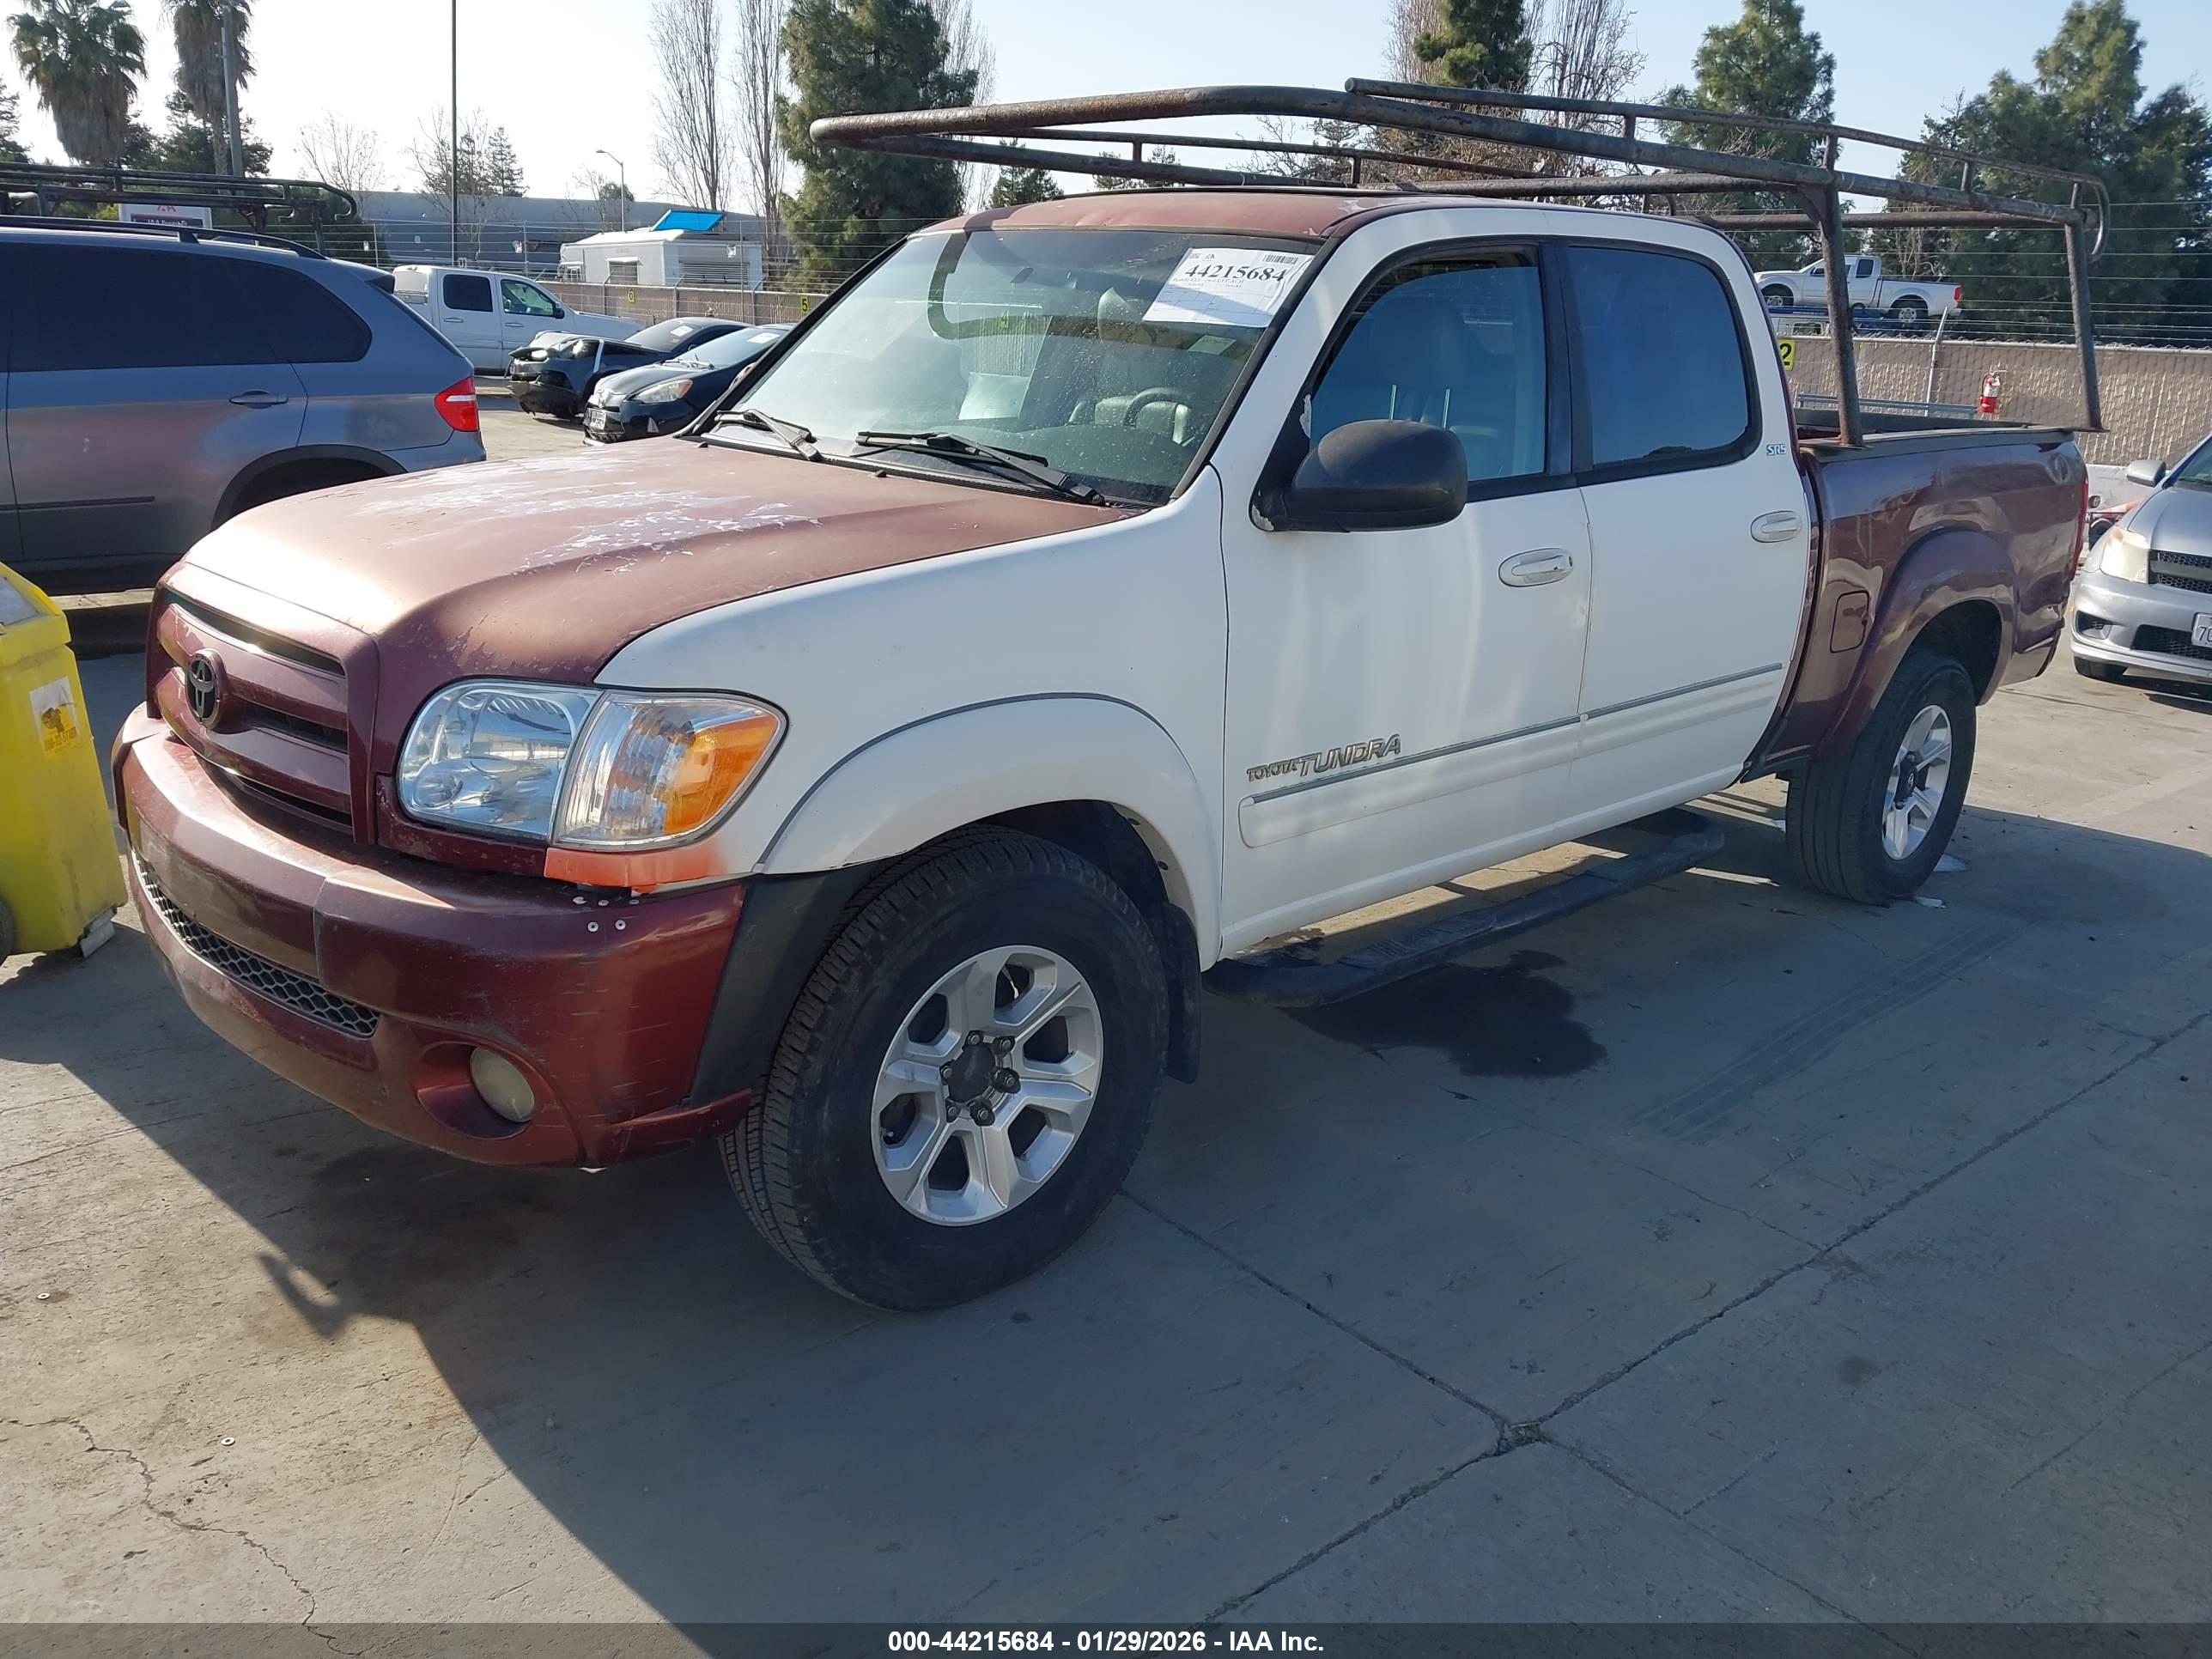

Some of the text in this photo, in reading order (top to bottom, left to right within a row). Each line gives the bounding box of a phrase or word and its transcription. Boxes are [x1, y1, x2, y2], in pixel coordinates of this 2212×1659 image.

[1185, 264, 1288, 282] 44215684
[801, 298, 808, 312] 5
[1779, 343, 1792, 366] 2
[1766, 443, 1786, 455] SR5
[1246, 733, 1401, 782] TOYOTA TUNDRA
